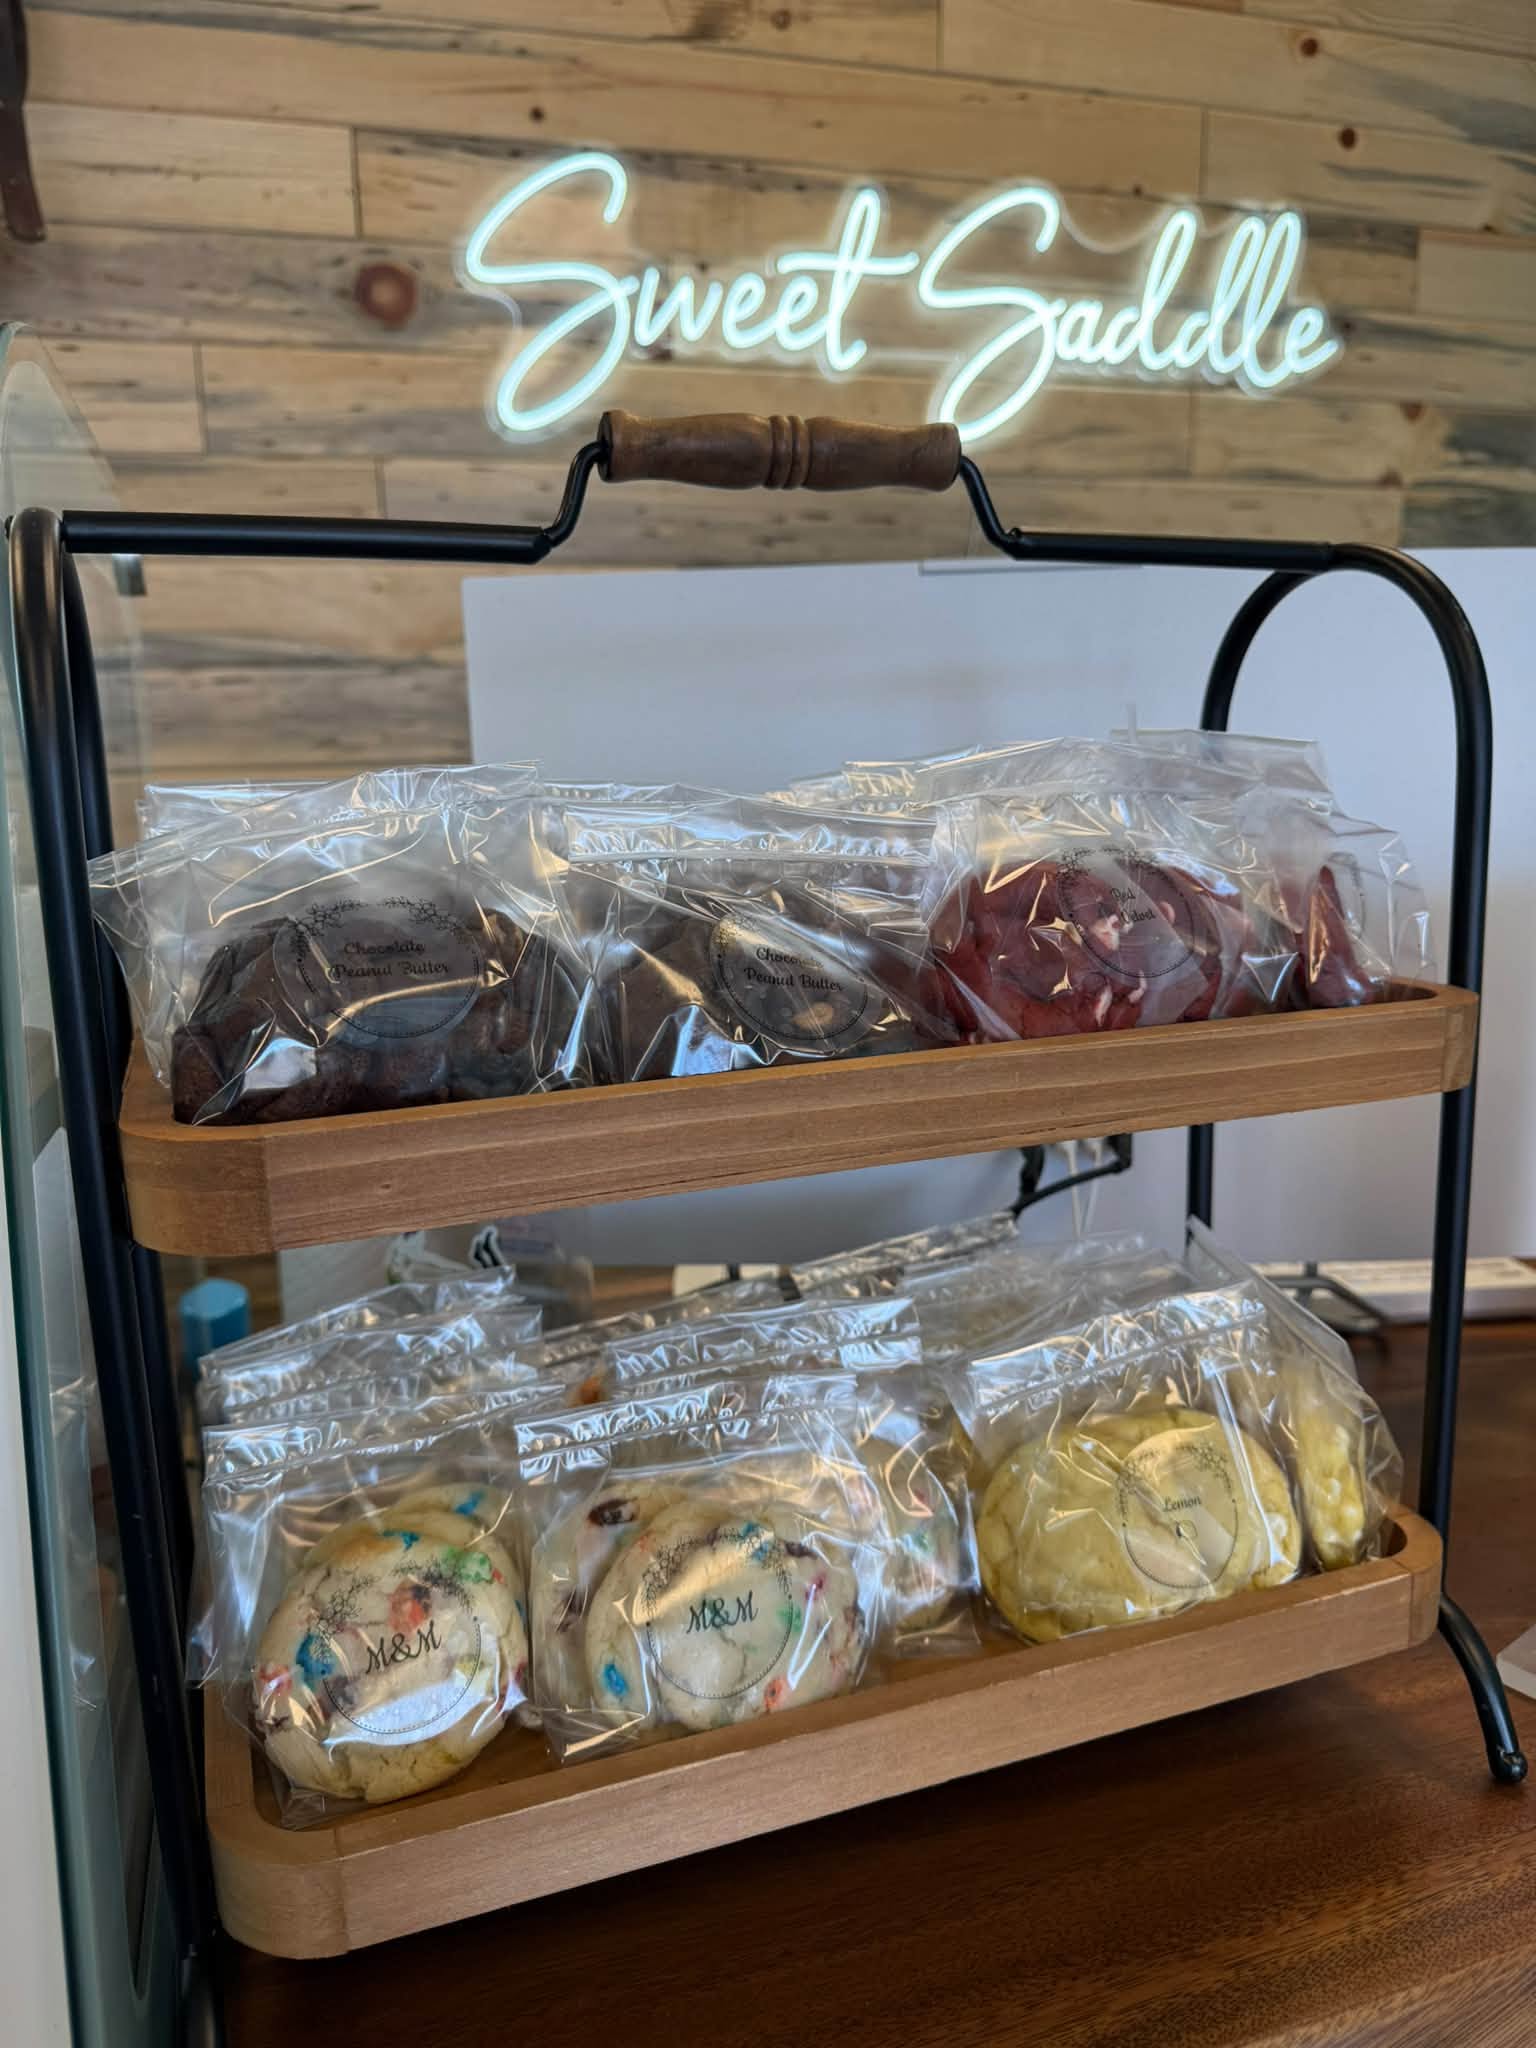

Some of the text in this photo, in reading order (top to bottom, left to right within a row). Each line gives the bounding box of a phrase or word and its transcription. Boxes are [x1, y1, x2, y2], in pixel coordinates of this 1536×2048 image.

[464, 150, 1341, 442] Sweet Saddle
[343, 940, 425, 954] Chocolate
[756, 947, 824, 968] Chocote
[331, 960, 450, 978] Peanut Butter
[743, 967, 843, 991] Peanut Butter
[1163, 1496, 1202, 1512] Lemon
[686, 1590, 758, 1634] M&M
[365, 1619, 442, 1674] M&M
